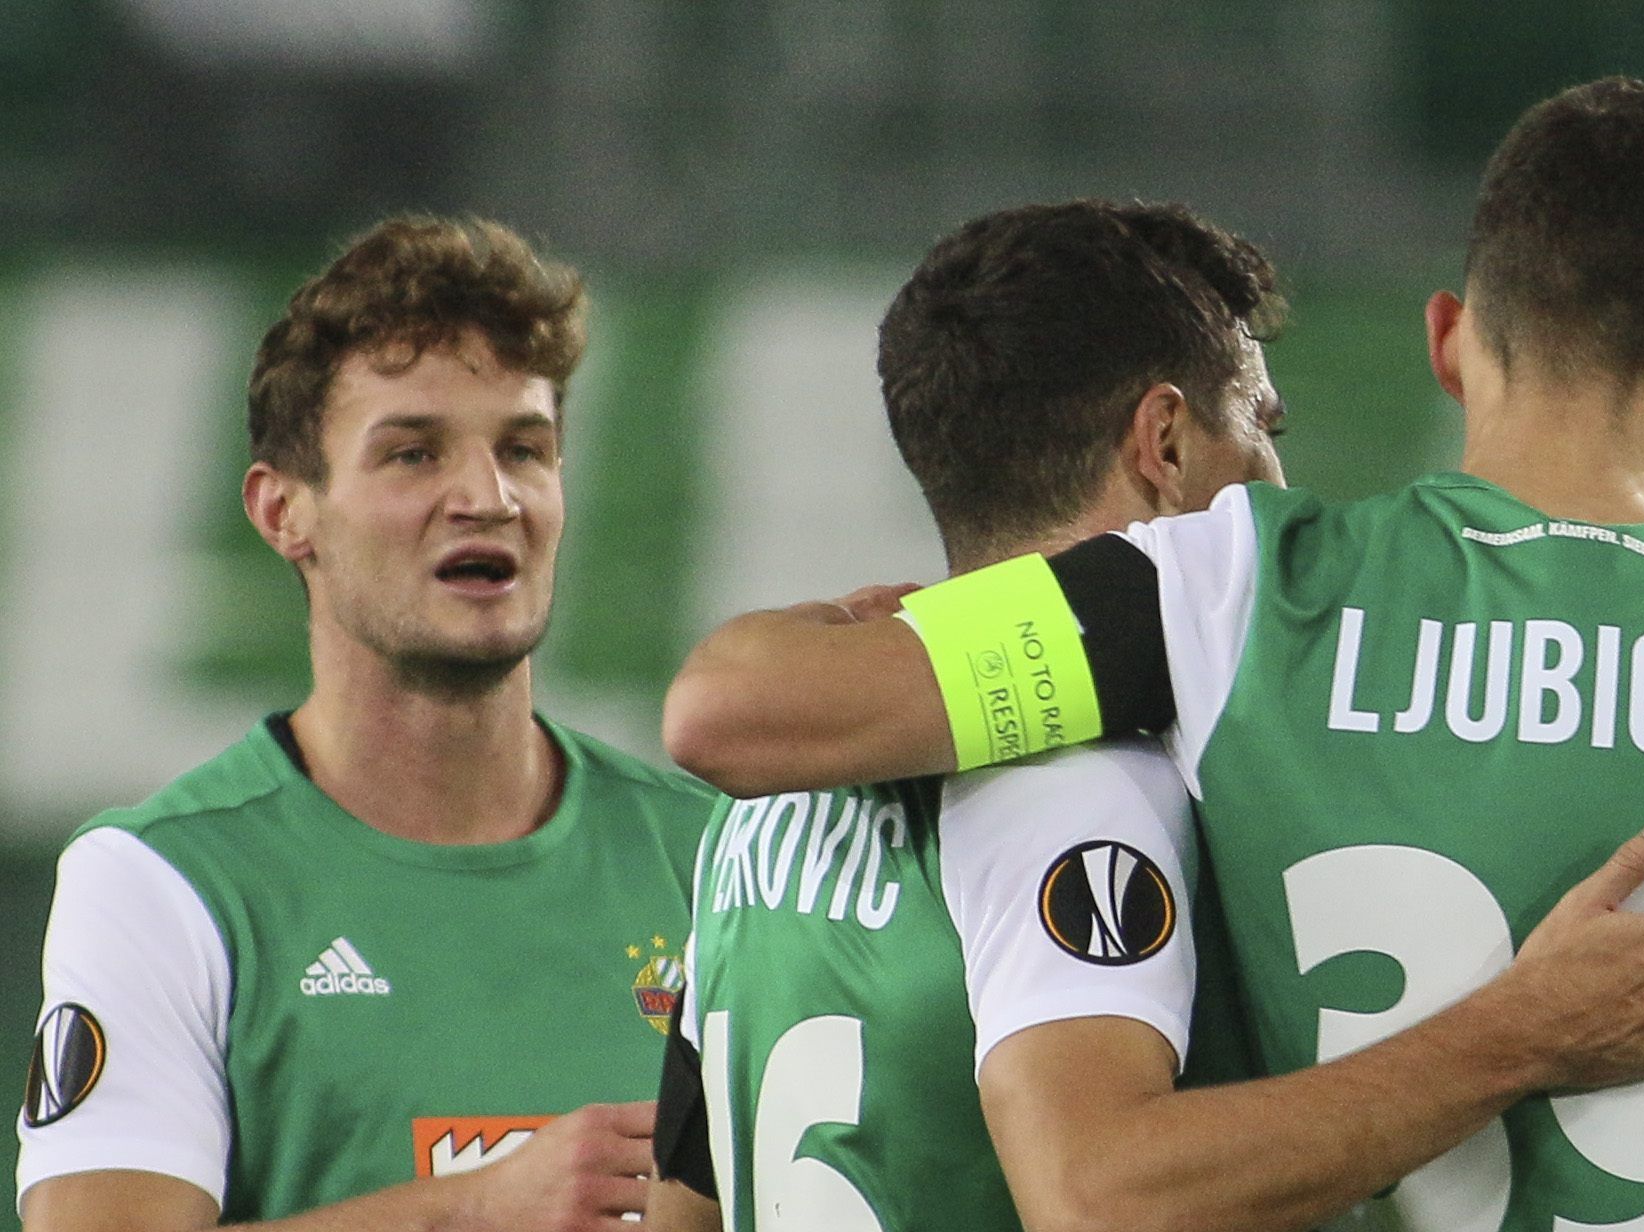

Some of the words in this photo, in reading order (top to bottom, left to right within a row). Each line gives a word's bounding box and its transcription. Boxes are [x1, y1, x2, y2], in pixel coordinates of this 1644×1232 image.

[1015, 621, 1044, 660] NO
[1032, 664, 1055, 701] TO
[300, 972, 391, 995] adidas
